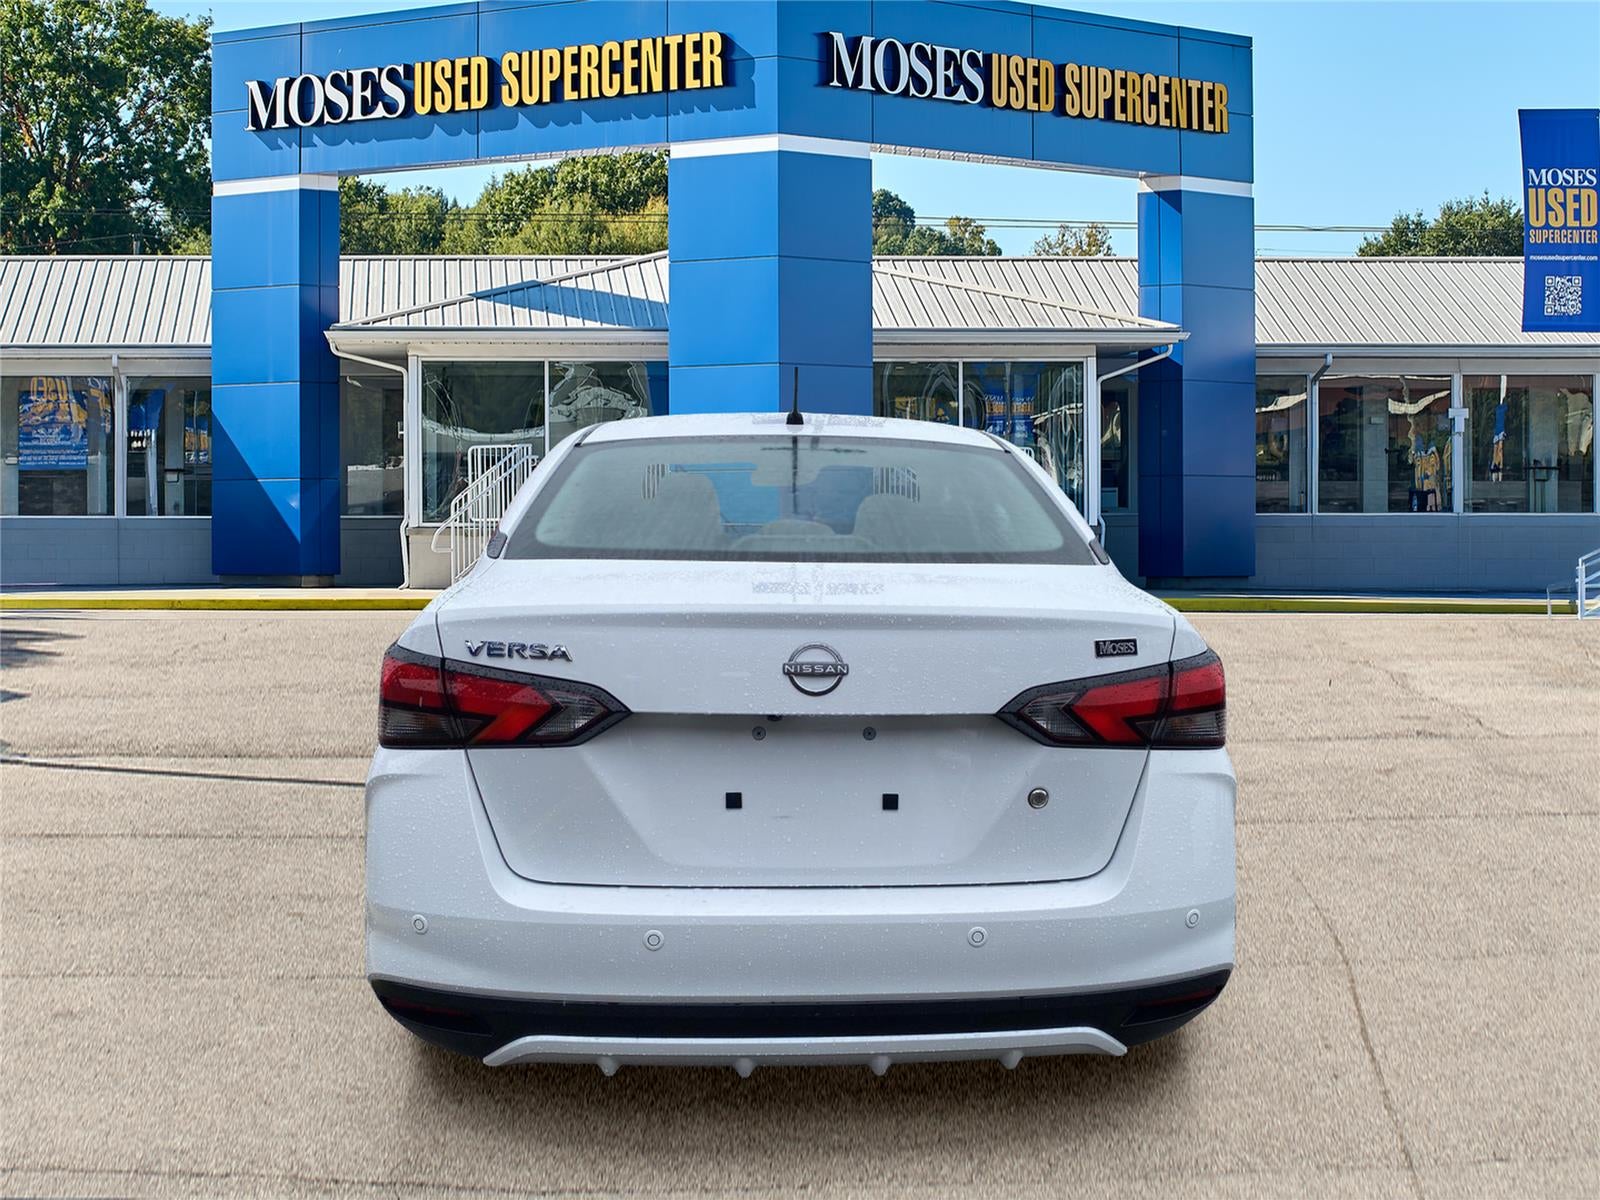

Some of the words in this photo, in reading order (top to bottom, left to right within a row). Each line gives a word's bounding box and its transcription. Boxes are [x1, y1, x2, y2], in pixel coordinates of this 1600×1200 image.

[244, 65, 406, 131] MOSES
[414, 56, 488, 115] USED
[501, 31, 724, 107] SUPERCENTER
[829, 31, 984, 104] MOSES
[991, 53, 1055, 112] USED
[1065, 63, 1229, 133] SUPERCENTER
[1528, 168, 1597, 186] MOSES
[1528, 187, 1598, 227] USED
[1529, 229, 1598, 244] SUPERCENTER
[465, 640, 573, 662] VERSA
[1099, 641, 1135, 655] MOSES
[784, 664, 847, 674] NISSAN
